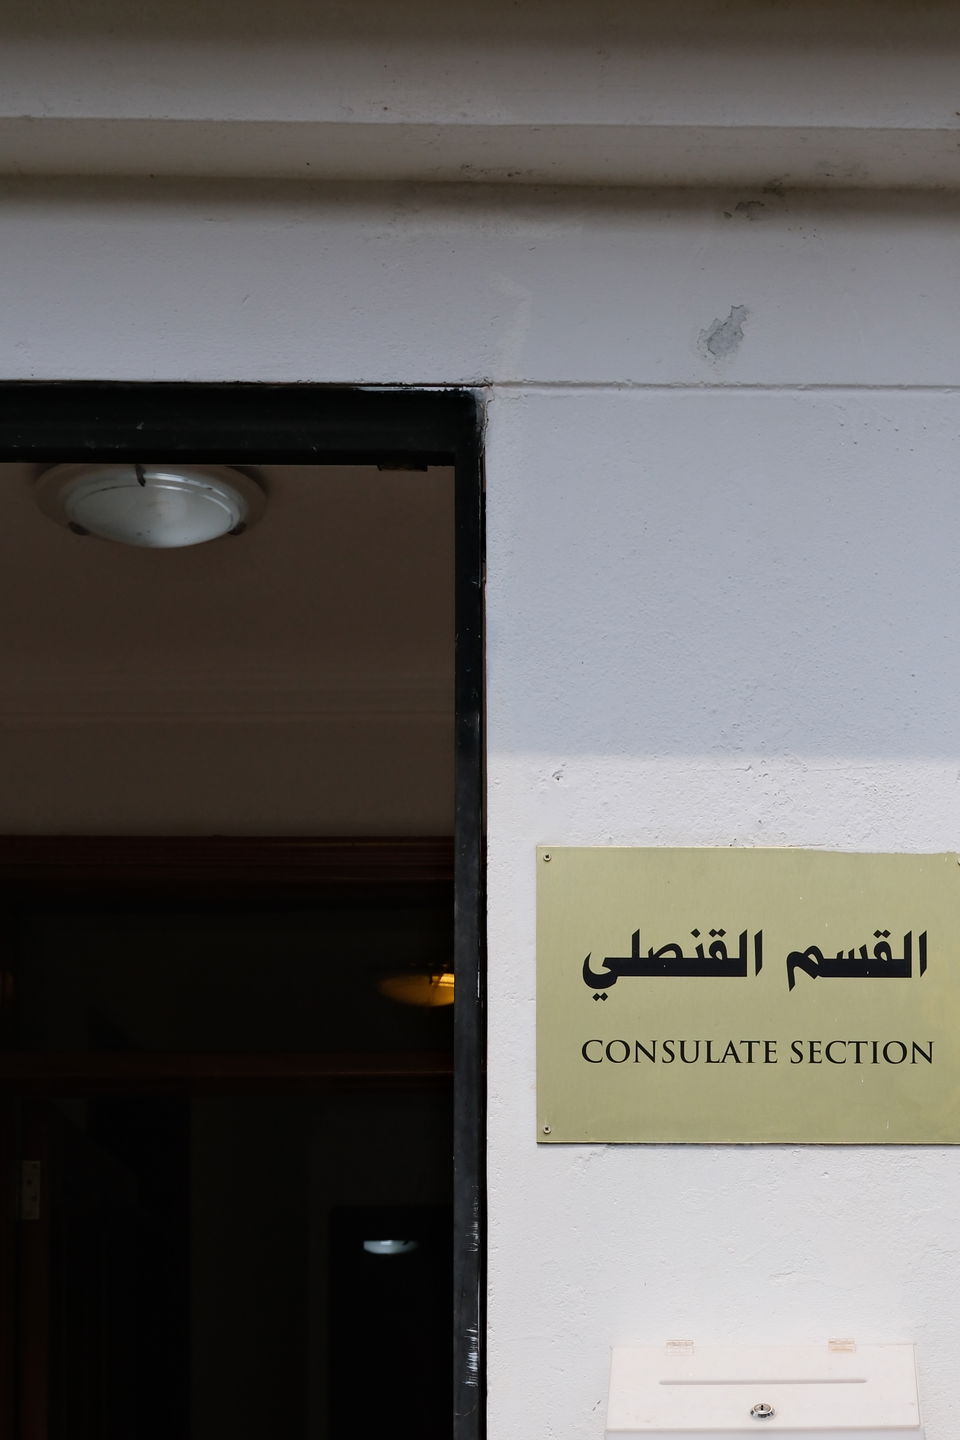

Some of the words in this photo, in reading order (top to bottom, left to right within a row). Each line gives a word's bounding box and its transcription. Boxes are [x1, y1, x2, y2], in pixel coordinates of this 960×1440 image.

[583, 929, 762, 1001] القنصلي
[787, 930, 927, 991] القسم
[582, 1040, 777, 1063] CONSULATE
[791, 1041, 933, 1064] SECTION
